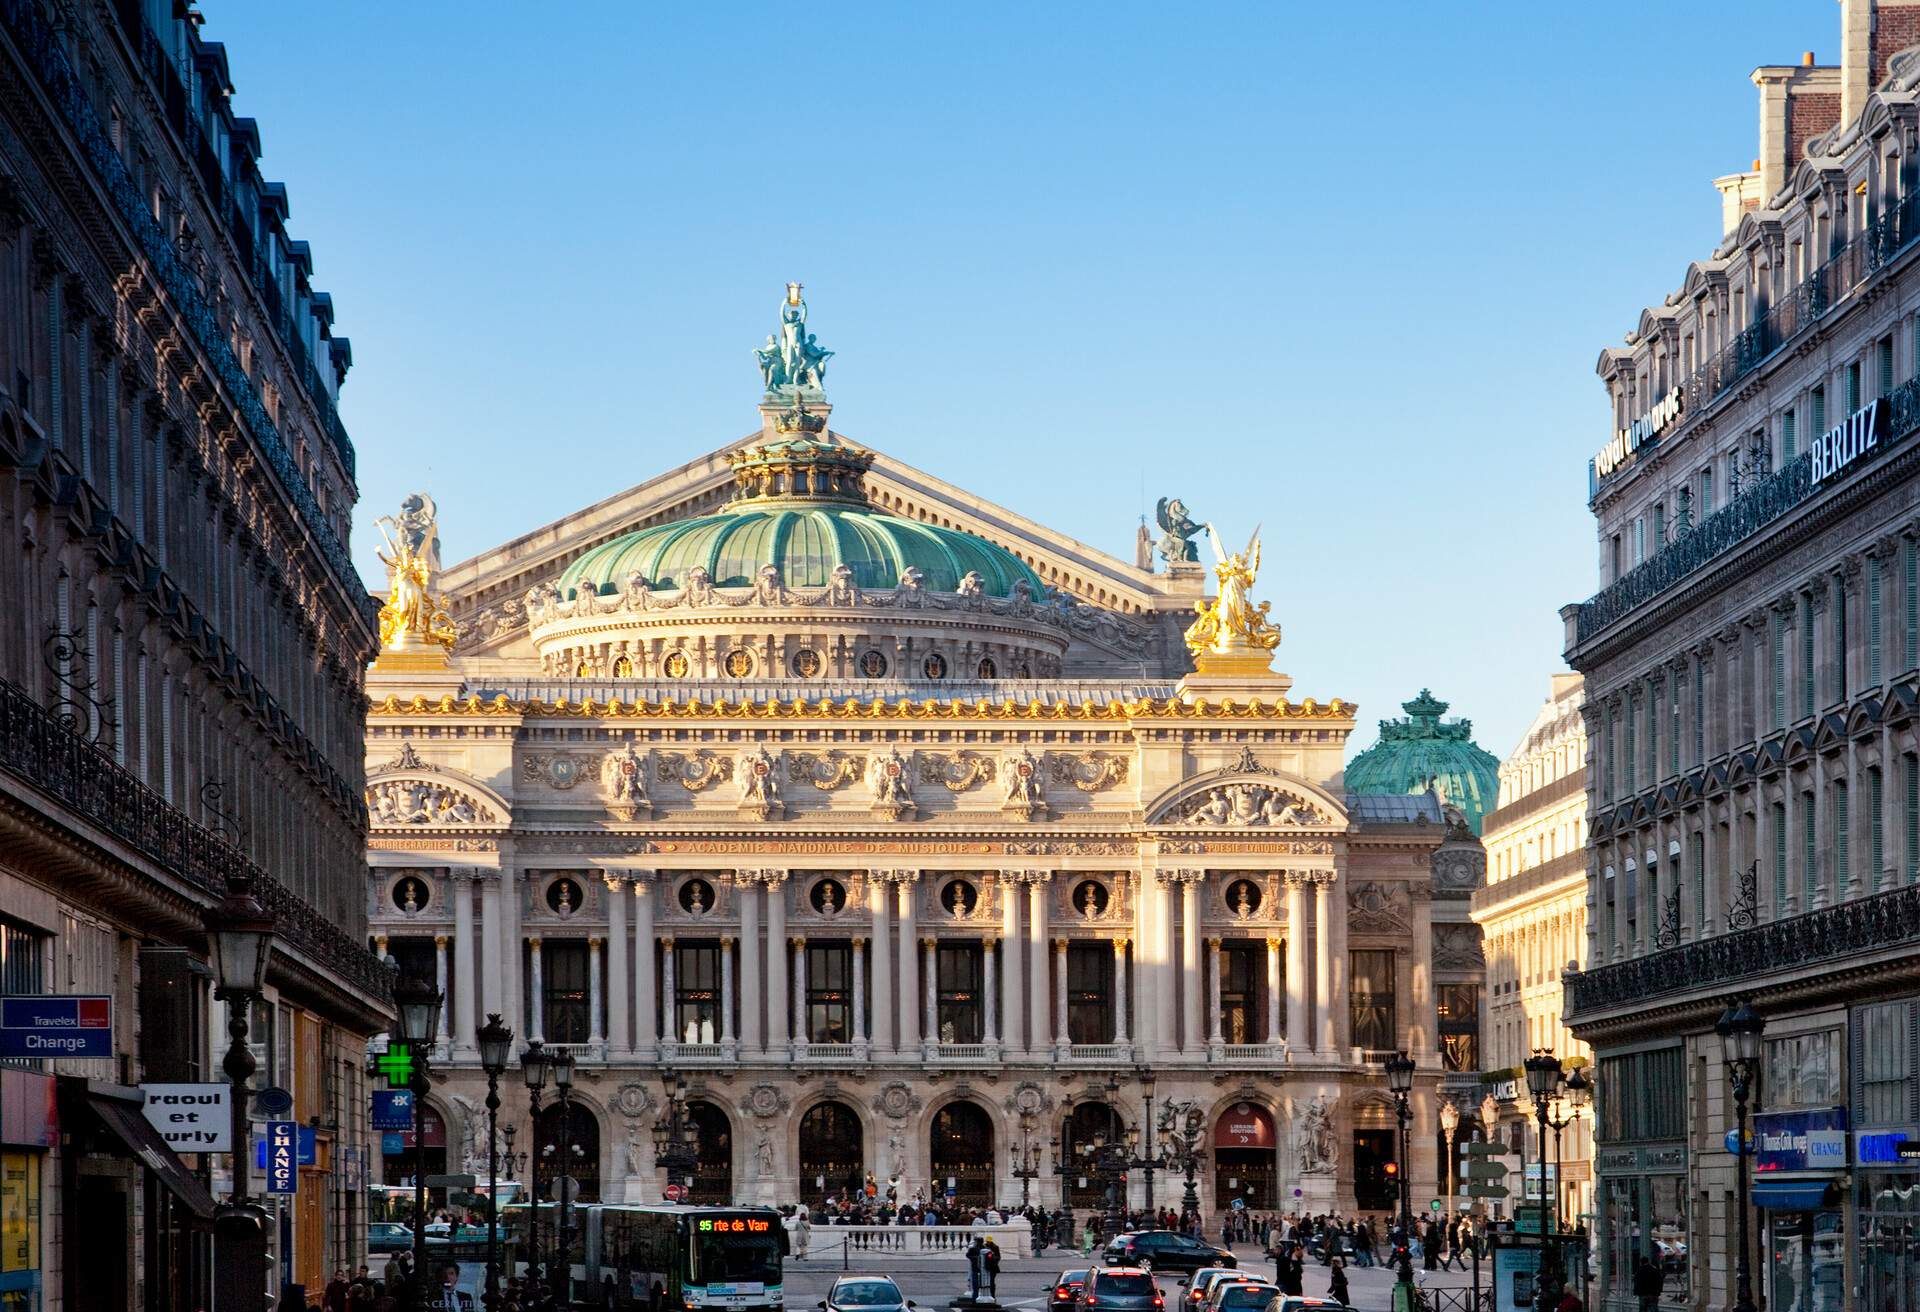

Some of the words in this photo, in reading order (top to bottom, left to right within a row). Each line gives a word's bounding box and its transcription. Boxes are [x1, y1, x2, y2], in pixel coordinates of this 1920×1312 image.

[1595, 429, 1624, 478] royal
[1624, 420, 1641, 456] air
[1641, 386, 1679, 441] maroc
[1811, 398, 1878, 486] BERLITZ
[687, 842, 765, 853] ACADEMIE
[778, 842, 852, 853] NATIONALE
[865, 842, 886, 853] DE
[898, 842, 968, 854] MUSIQUE
[1208, 843, 1239, 853] POESIE
[32, 1016, 76, 1026] Travelex
[25, 1035, 86, 1052] Change
[1493, 1080, 1518, 1100] LANCEL
[150, 1094, 220, 1105] raoul
[169, 1112, 199, 1123] et
[1811, 1142, 1843, 1156] CHANGE
[273, 1125, 291, 1190] CHANGE
[699, 1219, 712, 1231] 95
[713, 1219, 729, 1231] rte
[731, 1219, 745, 1231] de
